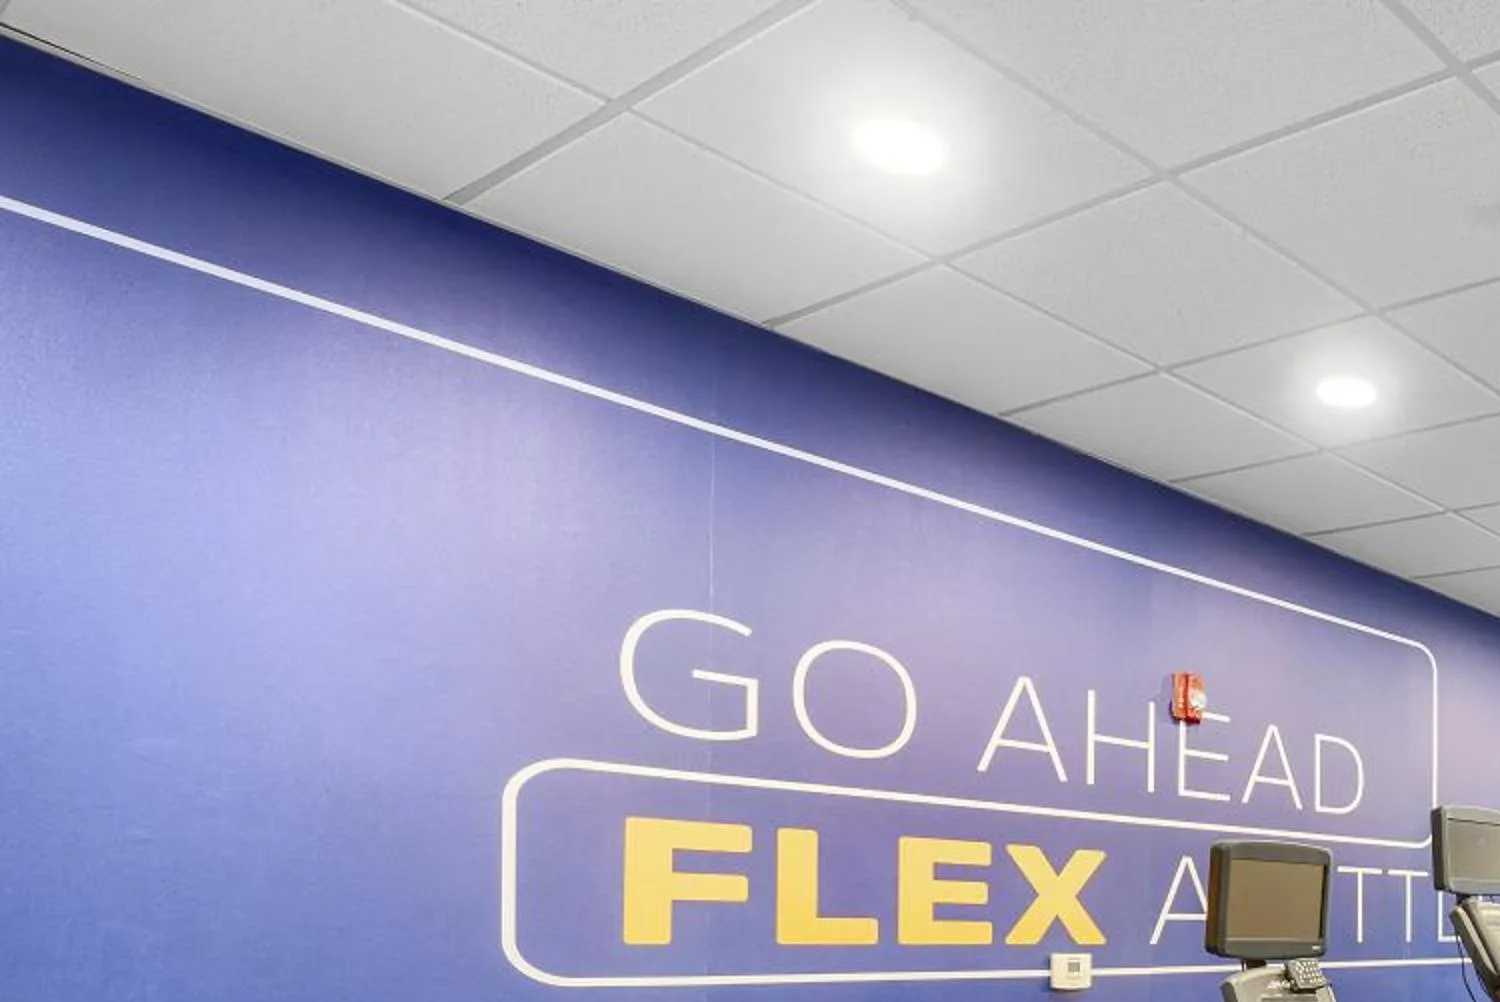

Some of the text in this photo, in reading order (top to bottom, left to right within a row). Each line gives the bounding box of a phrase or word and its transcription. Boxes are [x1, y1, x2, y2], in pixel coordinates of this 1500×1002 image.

[618, 608, 1366, 816] GO AHEAD
[621, 815, 1108, 946] FLEX
